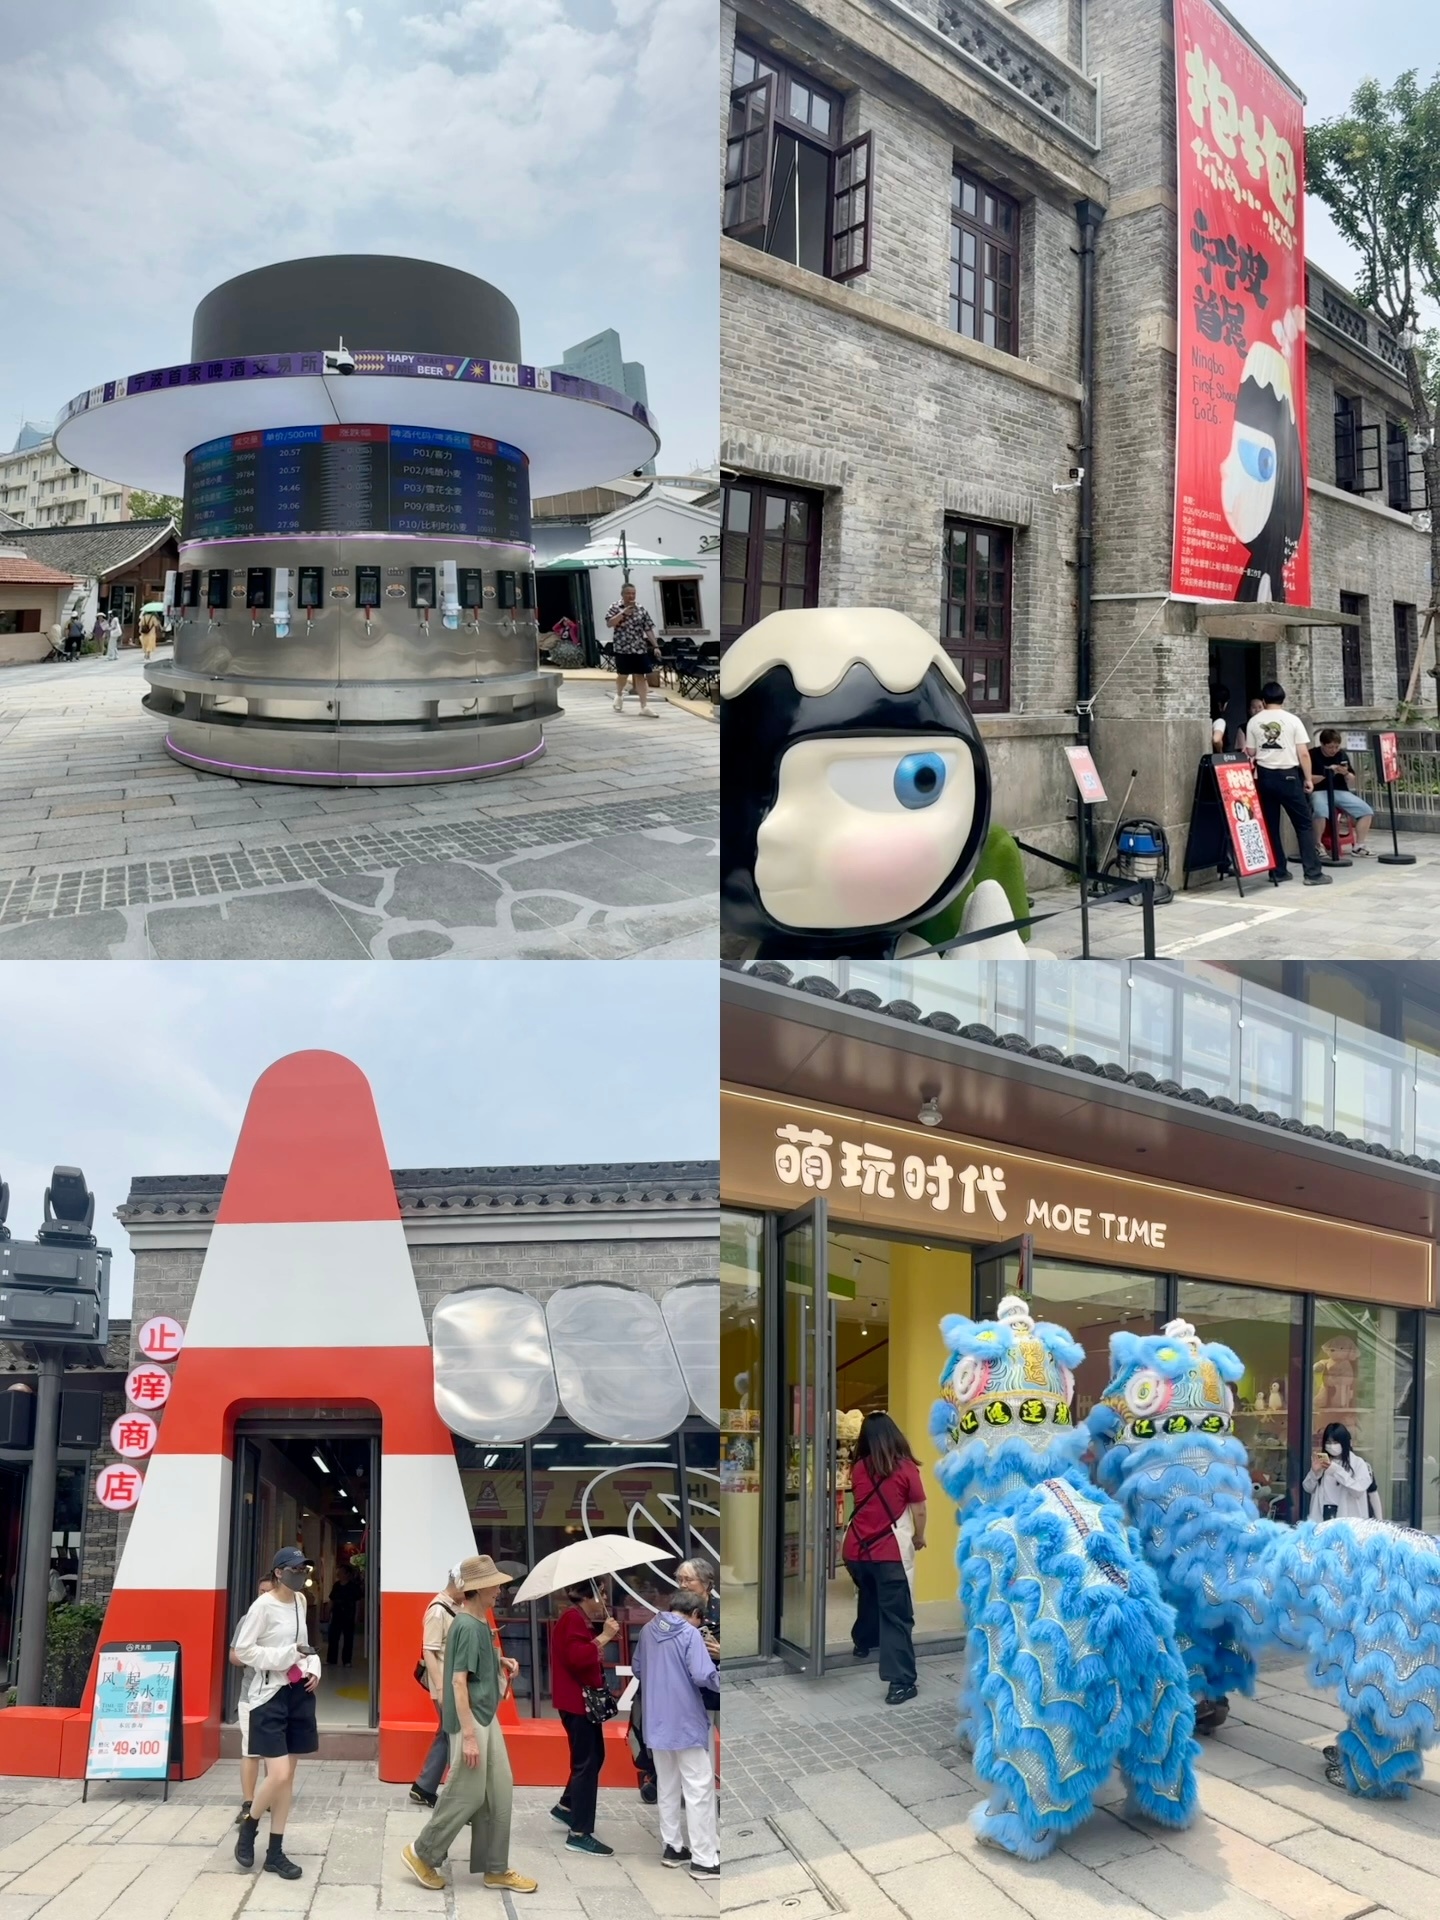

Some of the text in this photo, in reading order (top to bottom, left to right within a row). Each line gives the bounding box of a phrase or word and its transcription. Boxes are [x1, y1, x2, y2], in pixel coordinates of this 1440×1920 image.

[1190, 207, 1269, 310] 宁波
[386, 354, 415, 364] HAPY
[1191, 345, 1225, 382] Ningbo
[135, 355, 317, 391] 宁波首家啤酒交易所
[416, 365, 444, 376] BEER
[1192, 374, 1215, 400] First
[266, 430, 317, 441] 单价/500ml
[279, 448, 300, 457] 20.57
[279, 466, 300, 474] 20.57
[278, 484, 300, 492] 34.46
[277, 502, 300, 511] 29.06
[277, 521, 299, 529] 27.98
[774, 1123, 1007, 1223] 萌玩时代
[1026, 1199, 1168, 1249] MOE TIME
[102, 1323, 178, 1502] 止痒商店
